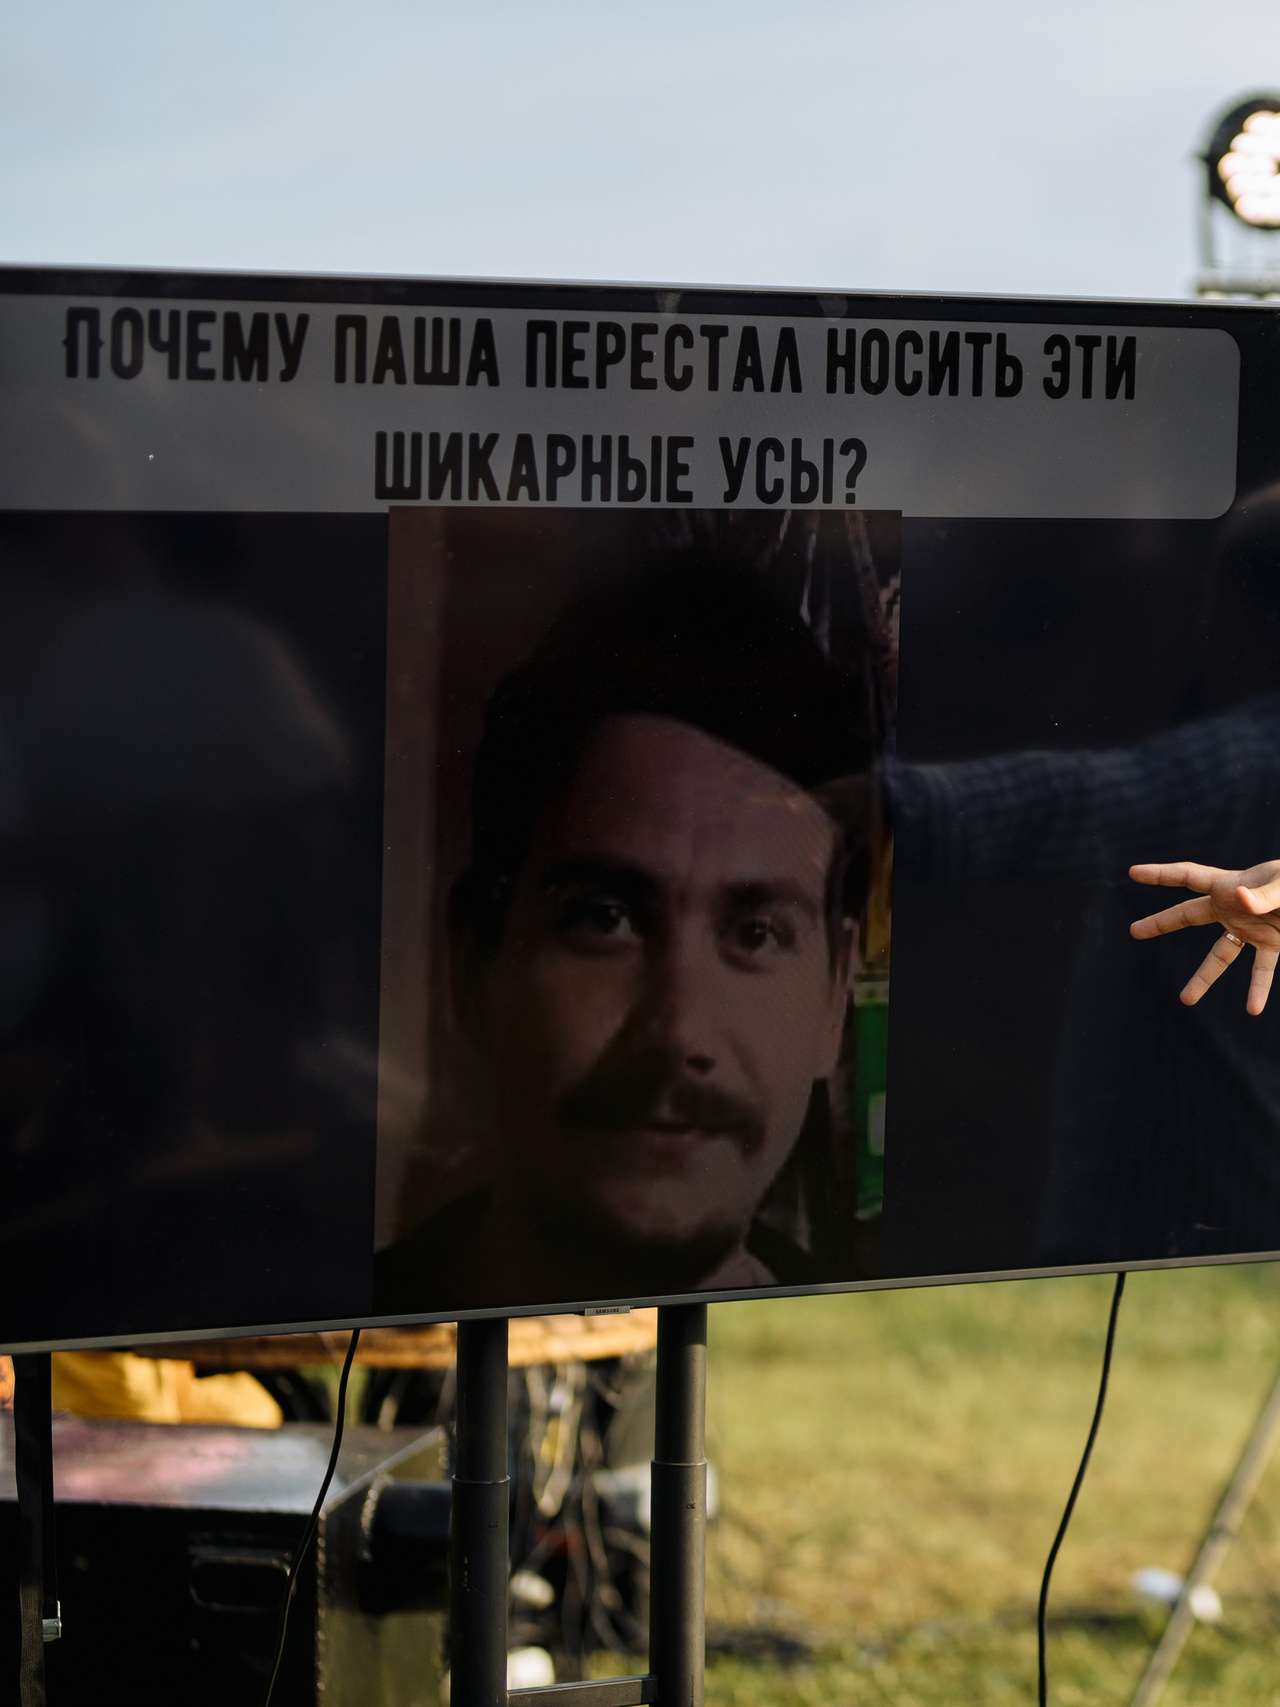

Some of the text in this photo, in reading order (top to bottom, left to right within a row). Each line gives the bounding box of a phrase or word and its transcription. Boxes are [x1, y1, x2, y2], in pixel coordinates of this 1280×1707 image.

[63, 306, 1137, 400] ПОЧЕМУ ПАША ПЕРЕСТАЛ НОСИТЬ ЭТИ
[375, 430, 868, 505] ШИКАРНЫЕ УСЫ?
